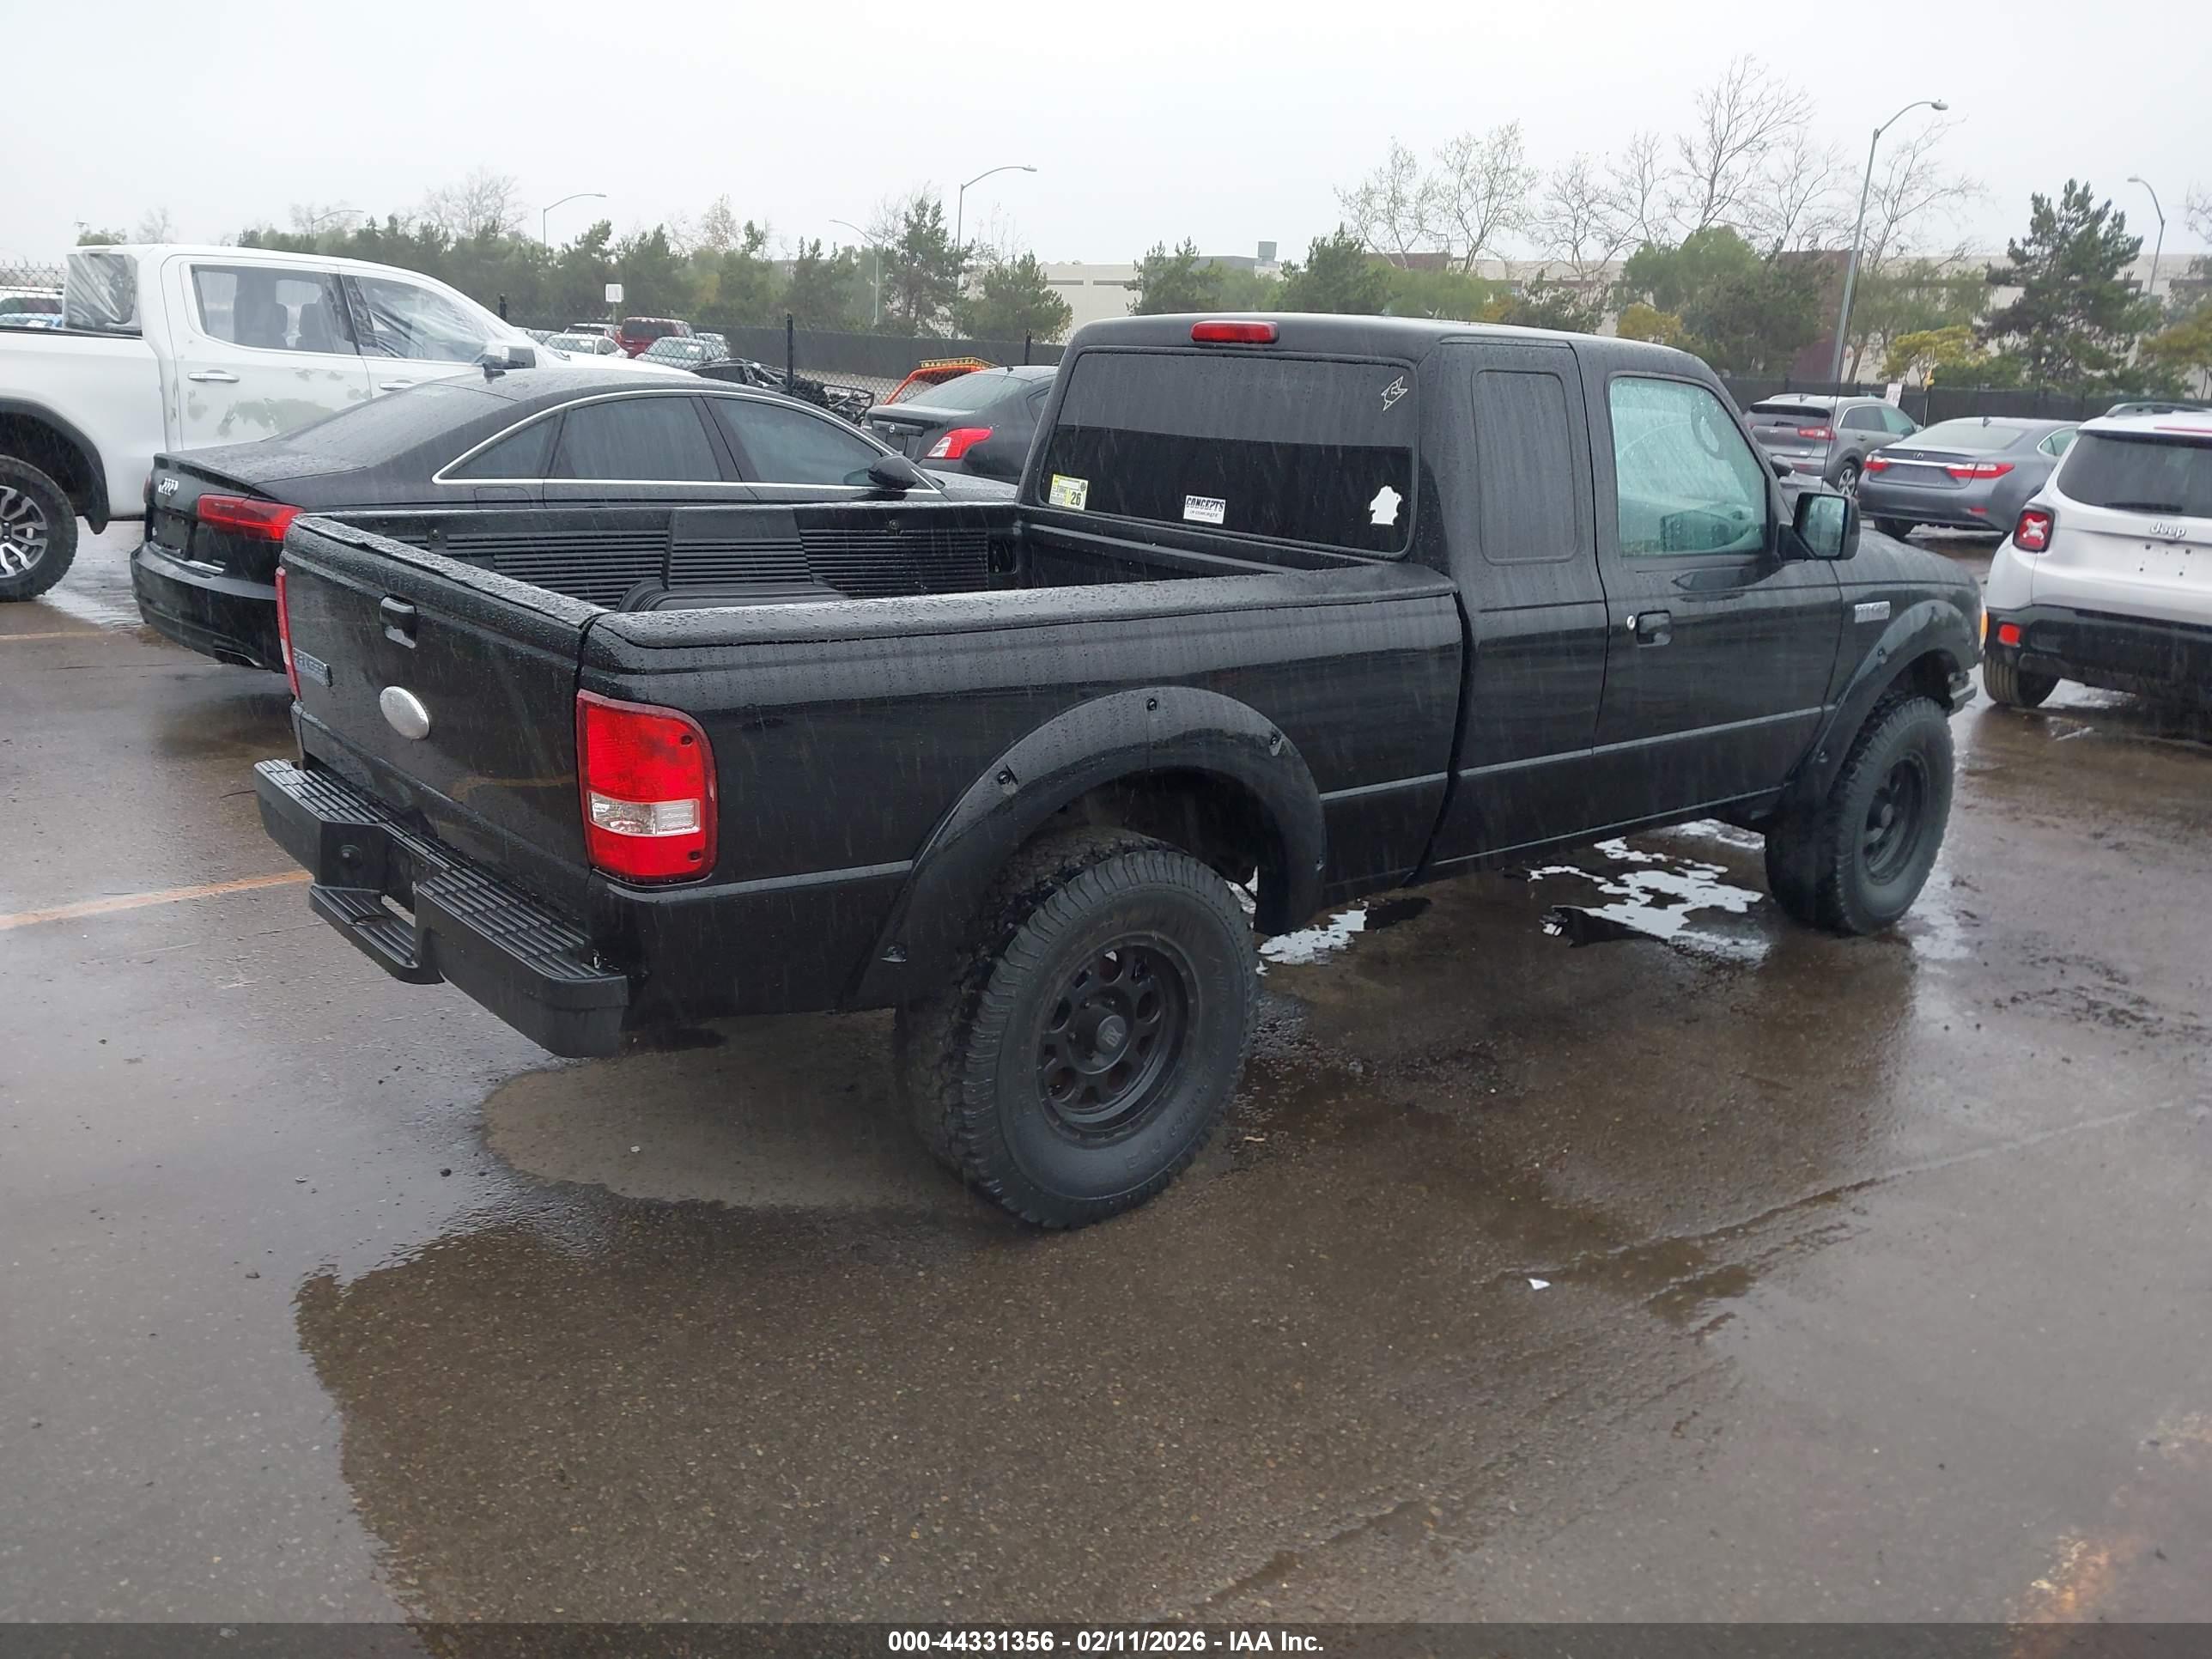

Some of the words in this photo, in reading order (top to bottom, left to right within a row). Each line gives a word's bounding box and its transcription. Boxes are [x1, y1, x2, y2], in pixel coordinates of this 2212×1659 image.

[1070, 491, 1082, 507] 26
[1186, 497, 1224, 512] CONCEPTS
[2150, 522, 2187, 539] Jeep
